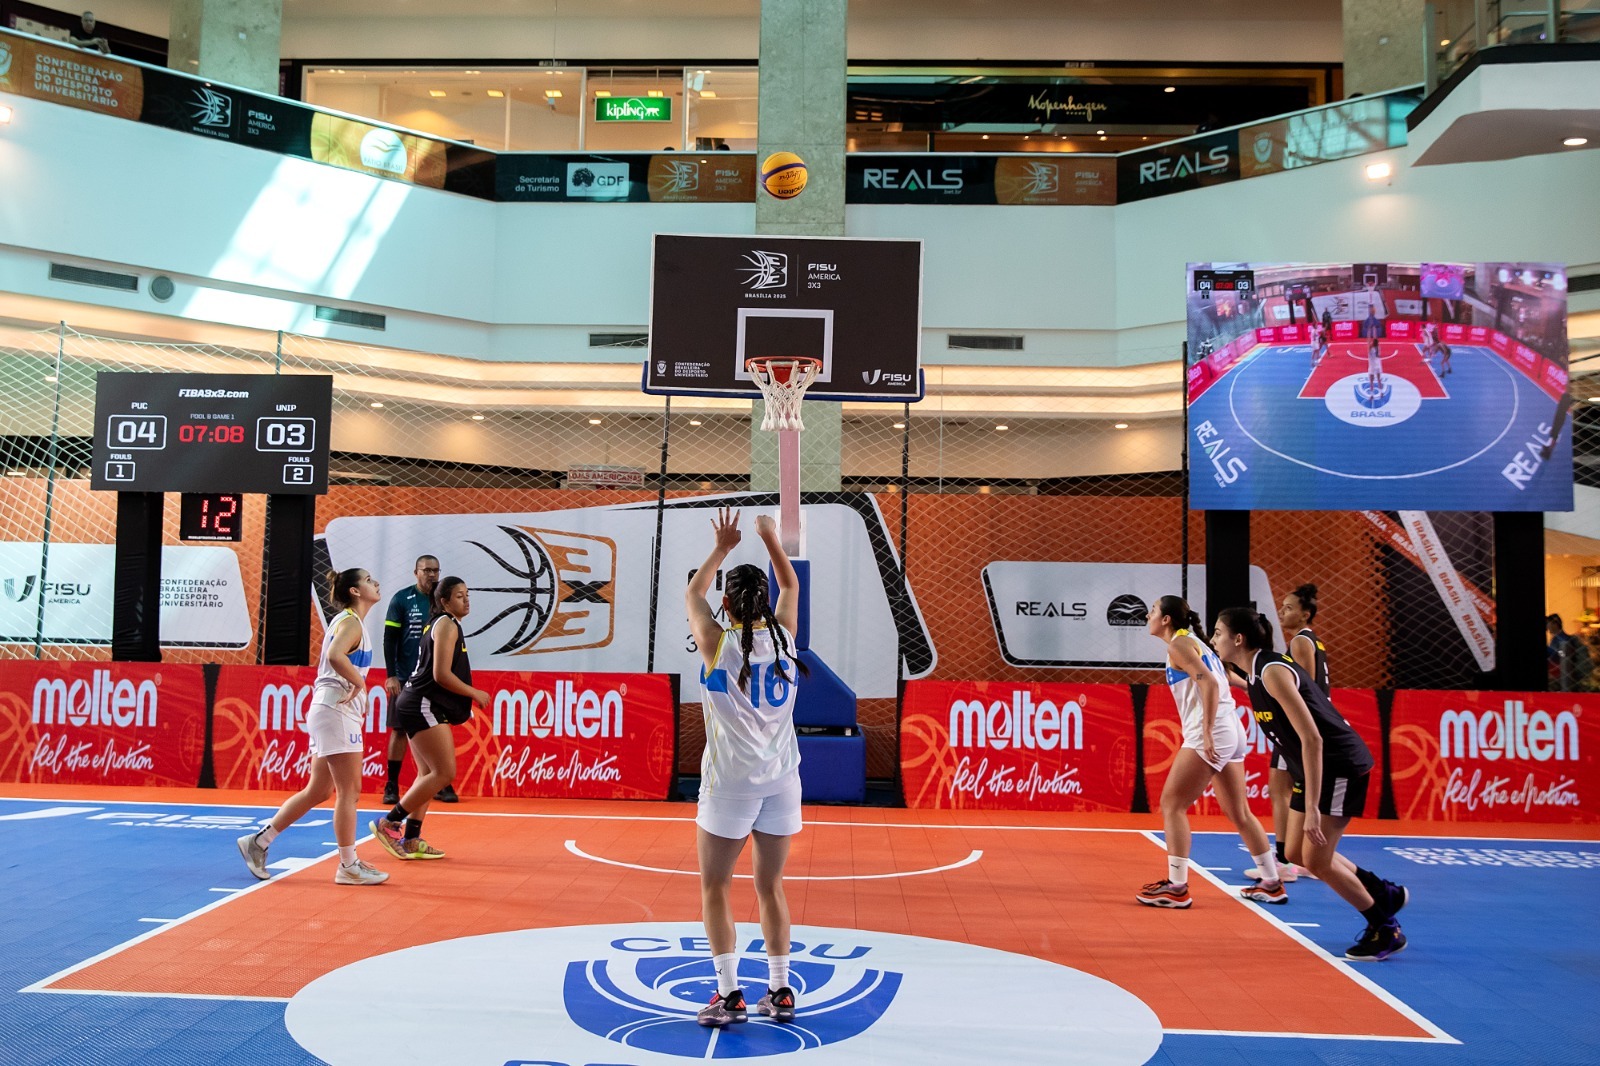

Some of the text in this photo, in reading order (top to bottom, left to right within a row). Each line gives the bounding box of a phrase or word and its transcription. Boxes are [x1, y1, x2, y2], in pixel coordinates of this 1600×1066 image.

[36, 54, 122, 82] CONFEDERAÇÃO
[36, 63, 99, 85] BRASILEIRA
[34, 82, 118, 107] UNIVERSITÁRIO
[35, 72, 112, 97] DO DESPORTO
[248, 109, 273, 122] FISU
[606, 103, 644, 119] kipling
[1028, 89, 1107, 121] Kopenhagen
[248, 119, 276, 131] AMERICA
[715, 169, 739, 177] FISU
[1140, 145, 1229, 184] REALS
[519, 176, 560, 184] Secretaria
[596, 175, 625, 186] GDF
[863, 168, 964, 190] REALS
[882, 374, 912, 382] FISU
[179, 388, 249, 399] FIBA3x3.com
[131, 402, 297, 412] PUC UNIP
[117, 421, 306, 446] 04 07:08 03
[1194, 420, 1248, 484] REALS
[115, 465, 304, 481] 1 2
[201, 496, 237, 533] 12
[44, 583, 91, 596] FISU
[1412, 520, 1439, 564] BRASÍLIA
[1461, 614, 1491, 658] BRASÍLIA
[1016, 601, 1087, 617] REALS
[750, 660, 790, 707] 16
[32, 669, 158, 728] molten
[259, 683, 387, 734] mon
[492, 680, 623, 739] molten
[949, 690, 1084, 751] molten
[1440, 700, 1579, 761] molten
[29, 733, 67, 775] feel
[64, 740, 93, 772] the
[257, 739, 312, 781] feel th
[491, 745, 530, 787] feel
[527, 753, 557, 784] the
[949, 756, 988, 799] feel
[986, 764, 1016, 796] the
[1441, 767, 1482, 812] feel
[1479, 776, 1510, 808] the
[86, 811, 333, 826] FISU
[109, 820, 260, 830] AMERICA
